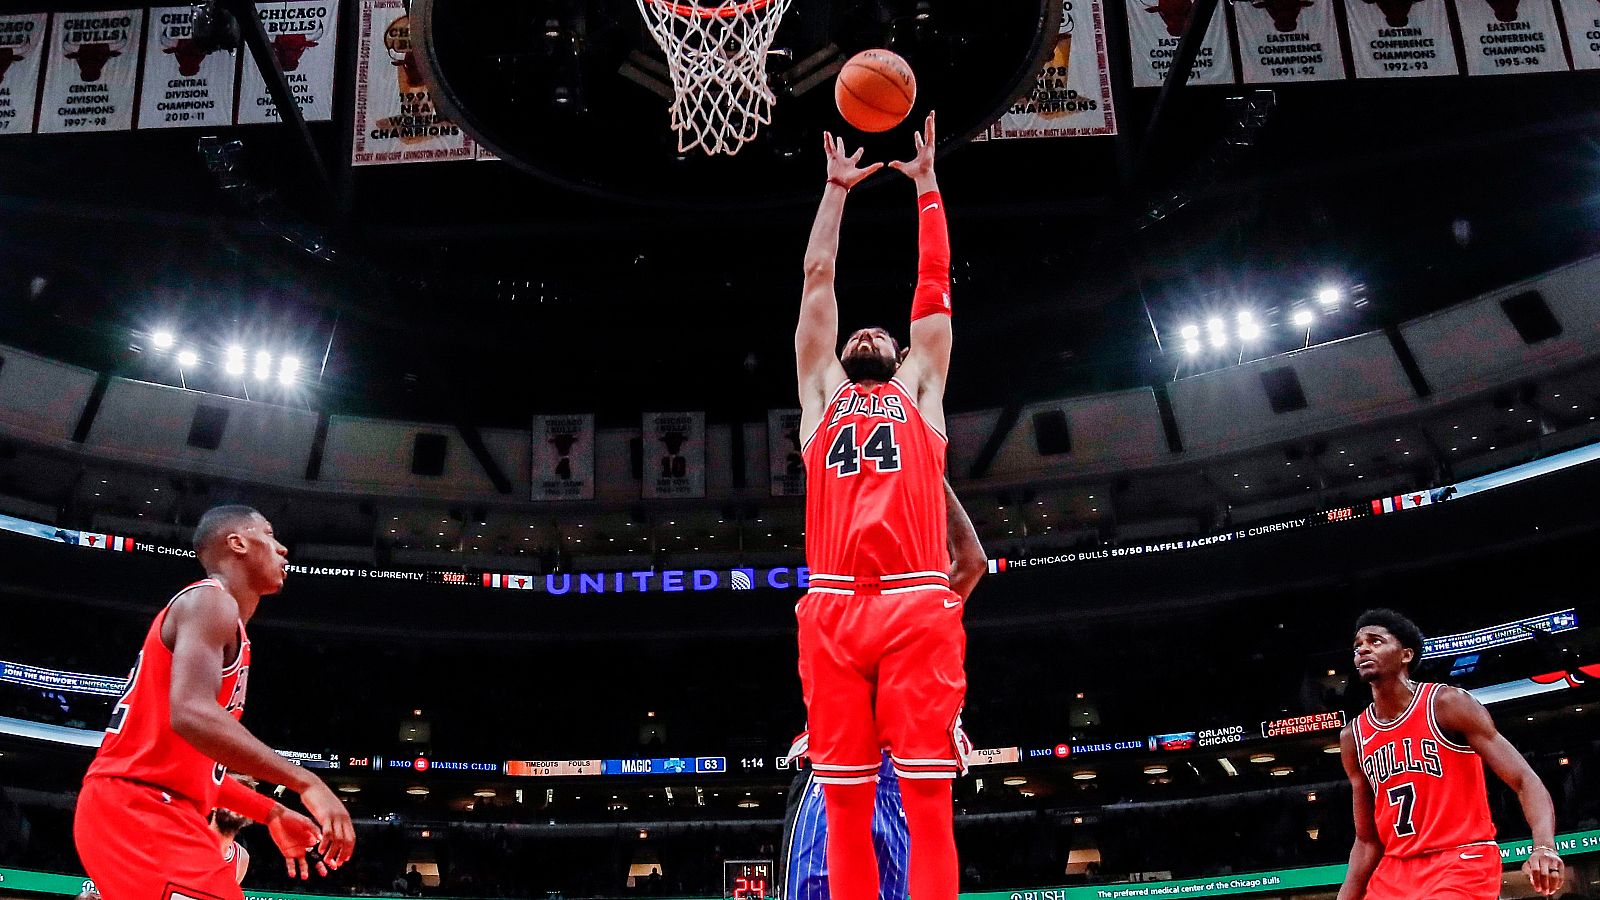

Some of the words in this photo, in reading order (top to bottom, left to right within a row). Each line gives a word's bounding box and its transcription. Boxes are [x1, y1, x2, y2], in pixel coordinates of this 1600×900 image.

[260, 7, 327, 20] CHICAGO
[64, 16, 131, 30] CHICAGO
[268, 20, 316, 32] BULLS
[1487, 21, 1530, 32] EASTERN
[72, 30, 120, 42] BULLS
[1267, 33, 1309, 43] EASTERN
[1378, 28, 1422, 38] EASTERN
[1480, 32, 1544, 44] CONFERENCE
[1258, 43, 1321, 55] CONFERENCE
[1370, 38, 1434, 49] CONFERENCE
[1373, 49, 1435, 60] CHAMPIONS
[1483, 44, 1545, 56] CHAMPIONS
[1261, 54, 1323, 65] CHAMPIONS
[69, 84, 108, 93] CENTRAL
[168, 79, 207, 88] CENTRAL
[67, 95, 109, 104] DIVISION
[165, 90, 208, 99] DIVISION
[399, 91, 431, 102] 1991
[58, 106, 115, 116] CHAMPIONS
[157, 101, 214, 111] CHAMPIONS
[401, 103, 430, 113] NBA
[371, 126, 459, 139] CHAMPIONS
[825, 422, 902, 478] 44
[1008, 559, 1027, 568] THE
[1029, 553, 1076, 567] CHICAGO
[1078, 549, 1109, 560] BULLS
[1111, 545, 1143, 558] 50/50
[1145, 541, 1184, 554] RAFFLE
[1186, 533, 1233, 549] JACKPOT
[1236, 530, 1246, 539] IS
[1248, 518, 1306, 537] CURRENTLY
[135, 542, 155, 553] THE
[309, 566, 355, 577] JACKPOT
[358, 568, 367, 577] IS
[369, 569, 424, 580] CURRENTLY
[545, 569, 720, 595] UNITED
[1434, 642, 1450, 651] THE
[1451, 634, 1493, 649] NETWORK
[4, 668, 23, 677] JOIN
[24, 671, 38, 679] THE
[38, 674, 77, 685] NETWORK
[1268, 715, 1313, 728] 4-FACTOR
[1315, 711, 1338, 722] STAT
[1198, 725, 1243, 739] ORLANDO
[1267, 723, 1320, 737] OFFENSIVE
[1321, 719, 1341, 729] REB
[1198, 734, 1241, 747] CHICAGO
[1030, 748, 1052, 757] BMO
[1072, 744, 1111, 754] HARRIS
[1114, 740, 1142, 750] CLUB
[329, 761, 338, 769] 33
[349, 757, 368, 767] 2nd
[390, 760, 411, 768] BMO
[431, 762, 468, 771] HARRIS
[471, 762, 497, 772] CLUB
[622, 759, 652, 773] MAGIC
[704, 760, 718, 769] 63
[741, 758, 763, 769] 1:14
[1387, 782, 1416, 838] 7
[743, 865, 767, 877] 1:14
[735, 878, 764, 900] 24
[1098, 890, 1112, 898] The
[1113, 888, 1149, 899] preferred
[1150, 885, 1179, 896] medical
[1180, 885, 1204, 894] center
[1205, 882, 1216, 890] of
[1215, 881, 1229, 889] the
[1230, 878, 1261, 890] Chicago
[1262, 876, 1281, 885] Bulls
